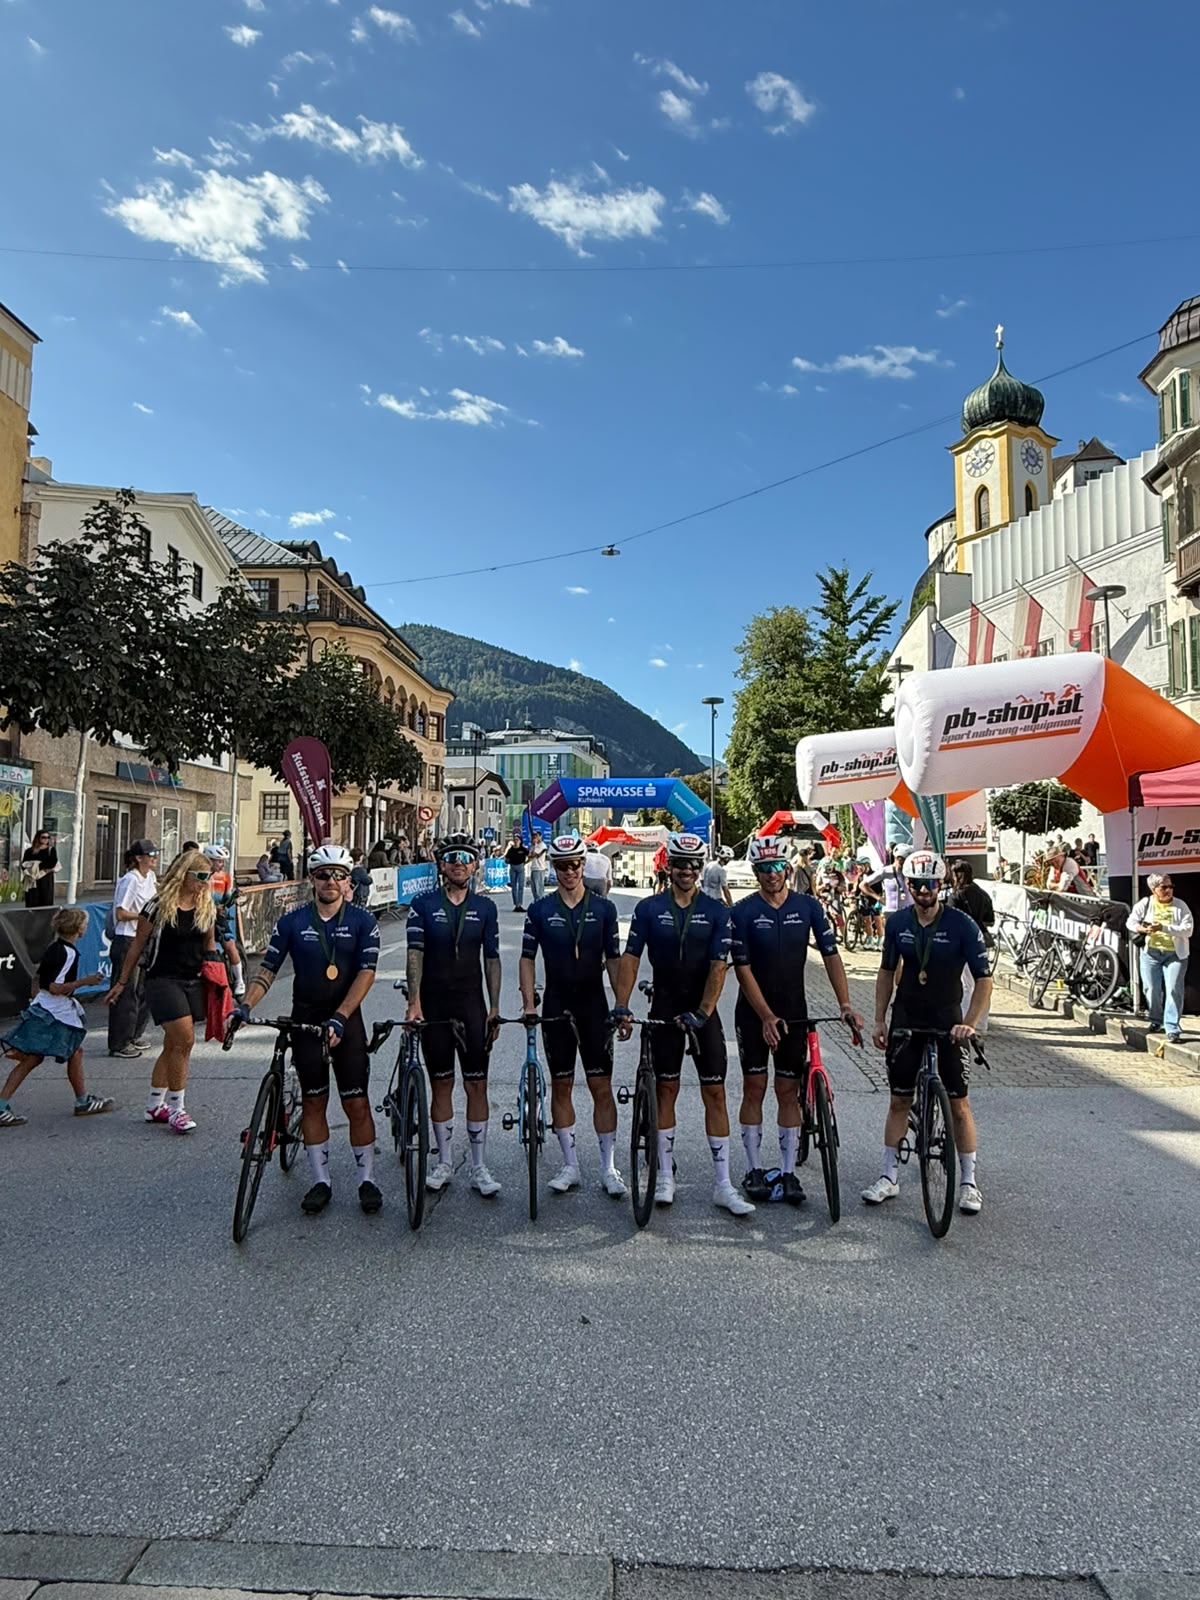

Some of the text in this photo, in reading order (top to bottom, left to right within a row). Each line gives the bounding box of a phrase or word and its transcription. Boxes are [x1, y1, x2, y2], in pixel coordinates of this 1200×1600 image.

[943, 692, 1084, 735] pb-shop.at
[0, 765, 24, 780] hen
[578, 786, 644, 797] SPARKASSE
[1137, 826, 1200, 852] pb-s
